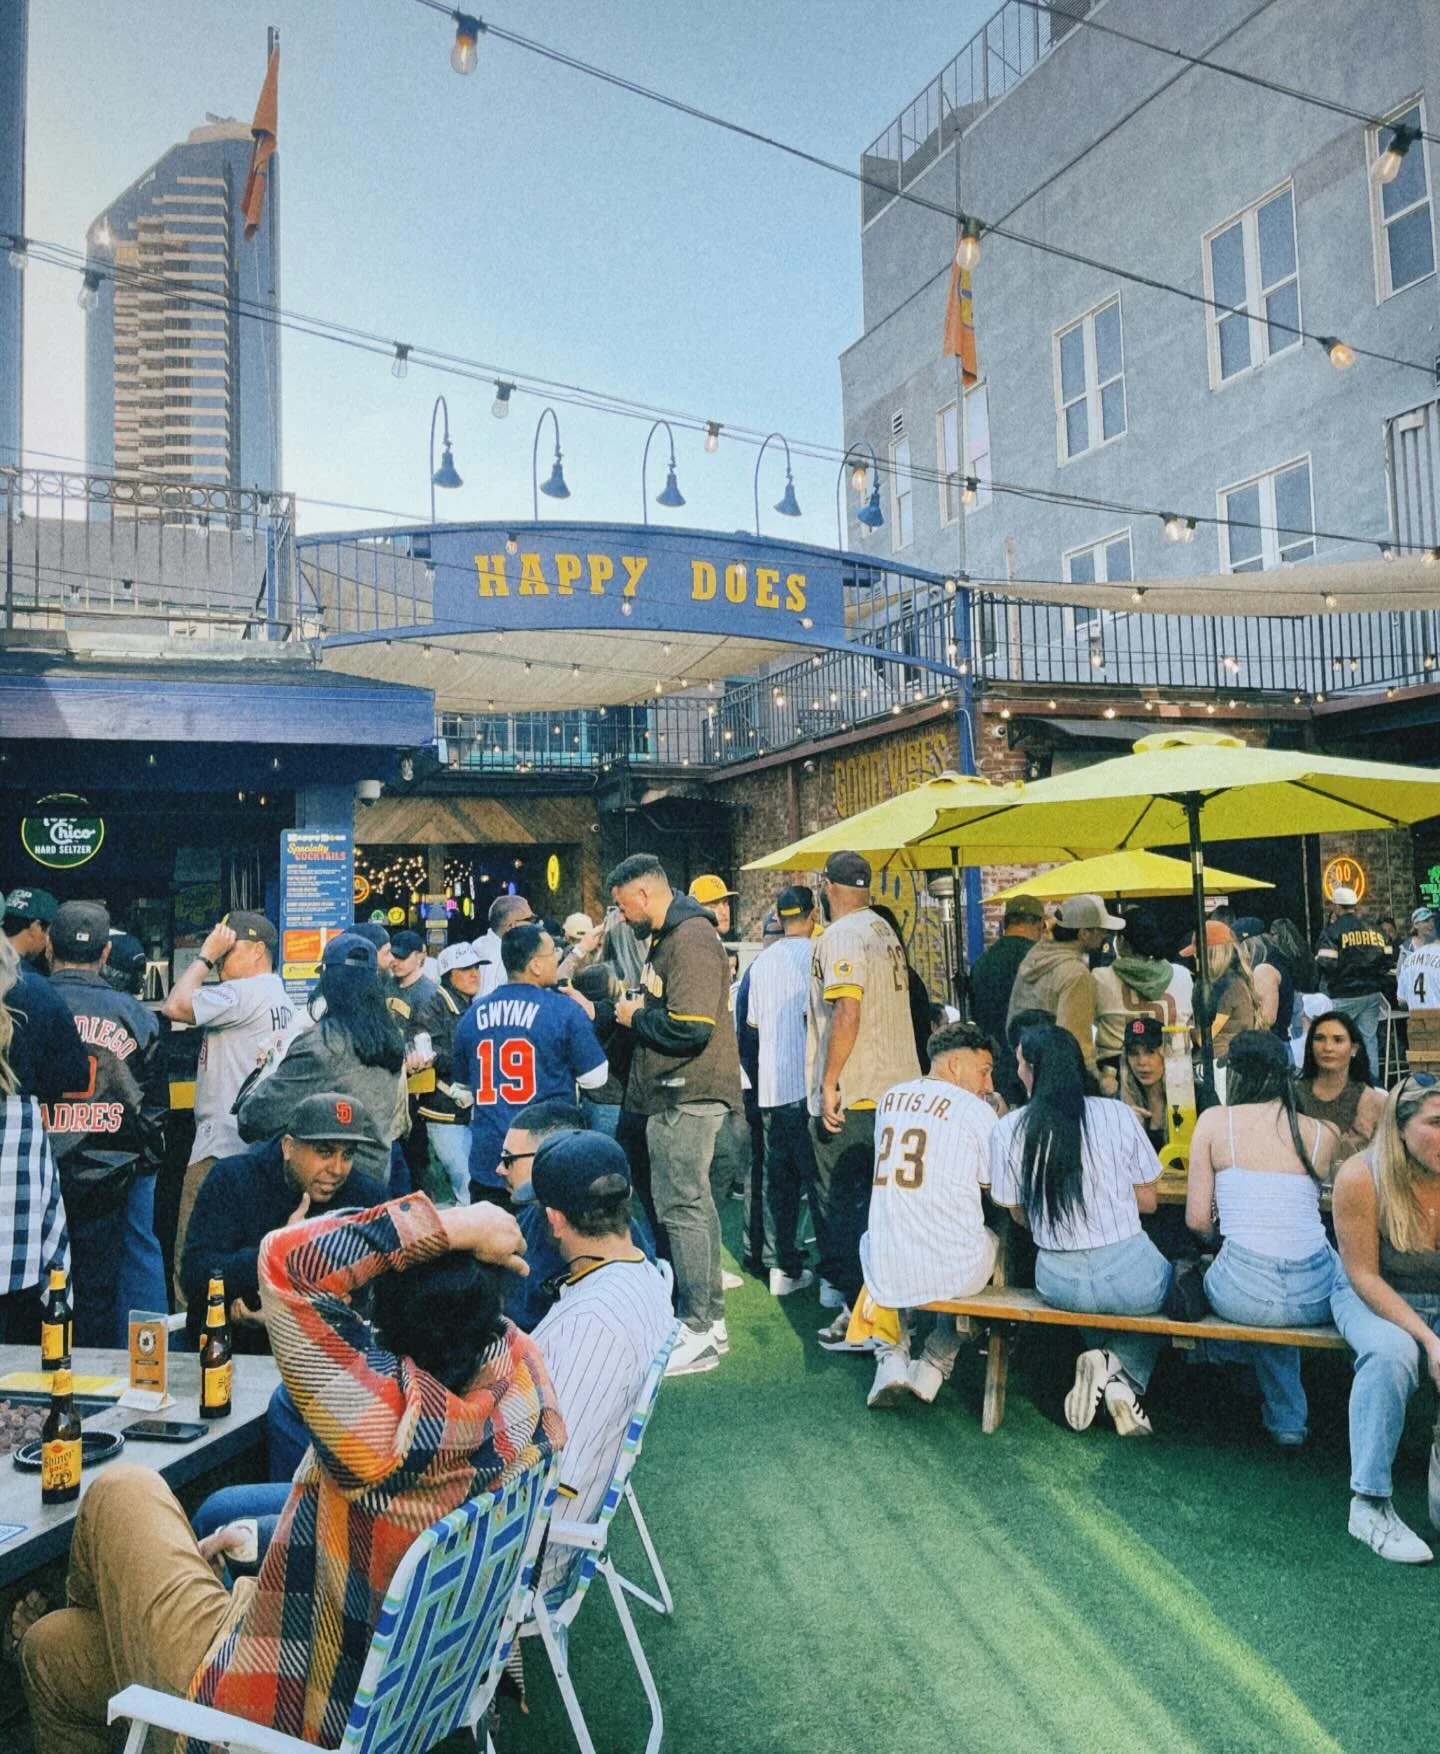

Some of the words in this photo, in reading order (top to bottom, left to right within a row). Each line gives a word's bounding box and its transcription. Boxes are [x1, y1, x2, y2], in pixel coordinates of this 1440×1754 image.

[474, 553, 649, 598] HAPPY
[690, 560, 808, 613] DOES
[50, 822, 96, 845] Chico
[35, 845, 56, 854] HARD
[59, 845, 92, 854] SELTZER
[287, 842, 329, 855] Specialty
[295, 851, 346, 860] COCKTAILS
[1341, 929, 1386, 949] PADRES
[1414, 972, 1425, 1003] 4
[477, 999, 540, 1031] GWYNN
[477, 1038, 536, 1105] 19
[336, 1101, 353, 1125] SD
[879, 1092, 925, 1116] ATIS
[925, 1095, 951, 1120] JR.
[873, 1125, 928, 1190] 23
